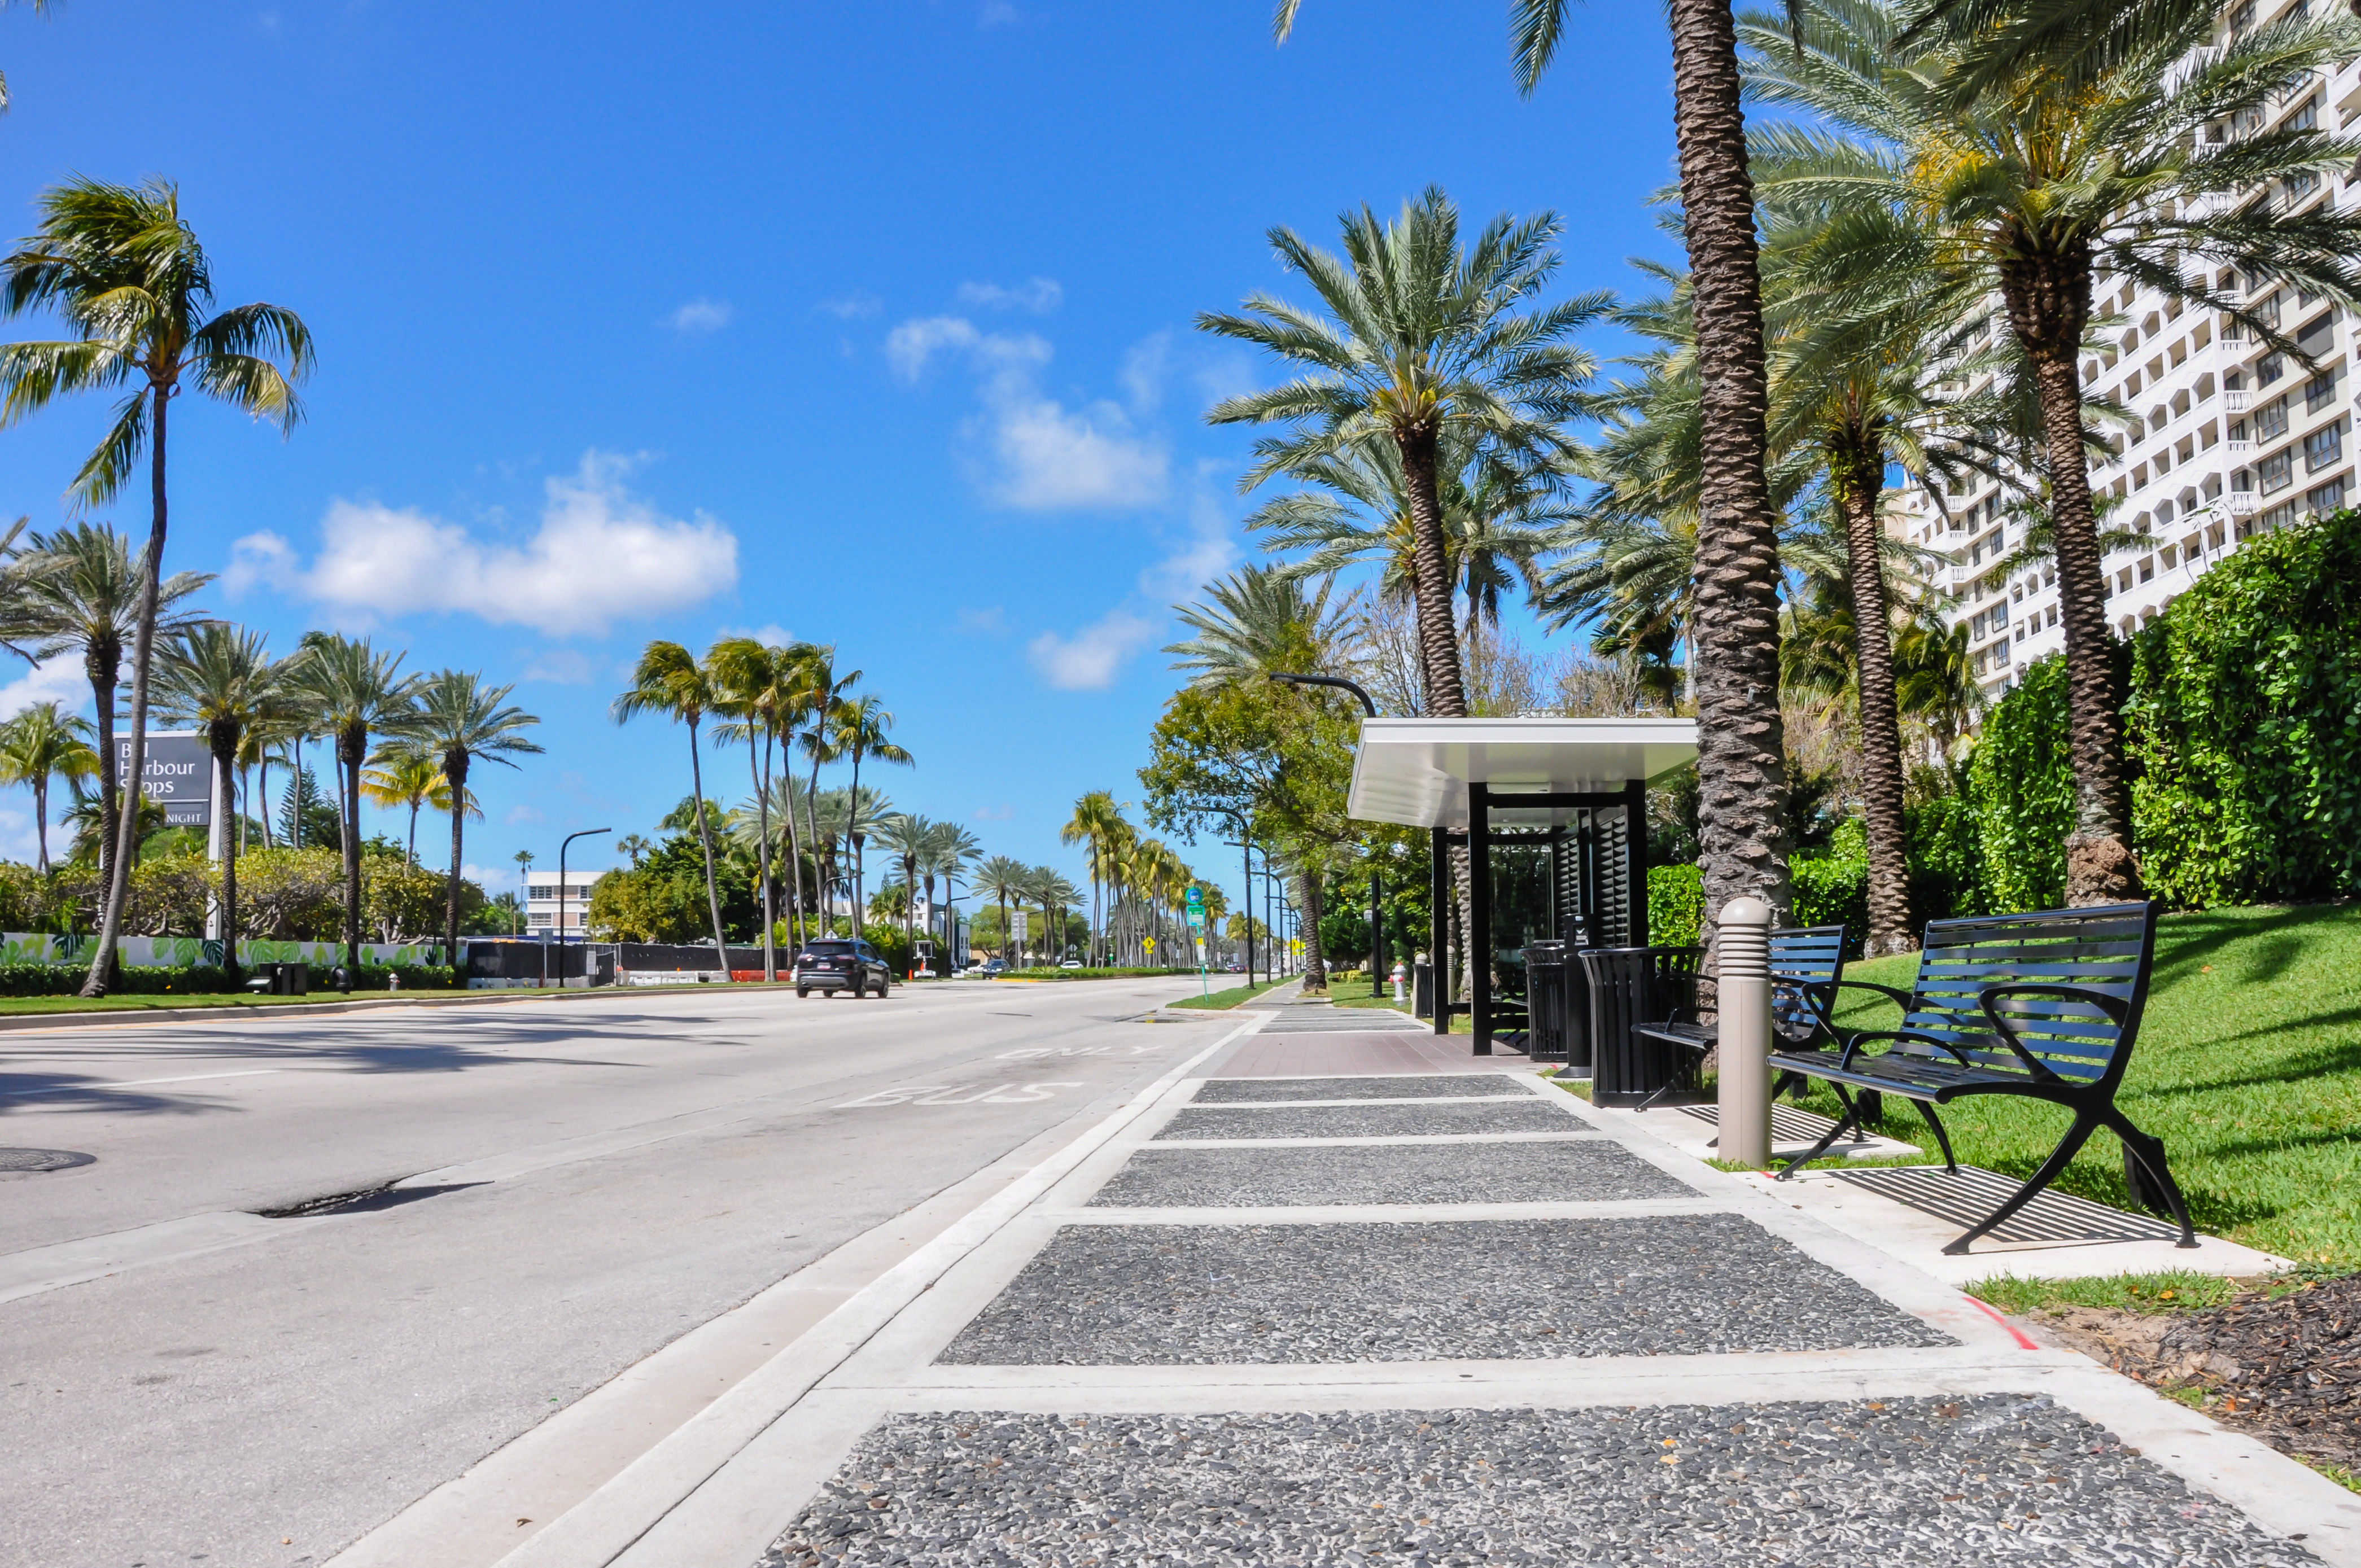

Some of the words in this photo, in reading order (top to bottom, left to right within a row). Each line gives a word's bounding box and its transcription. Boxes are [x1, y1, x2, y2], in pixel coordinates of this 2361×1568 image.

[121, 742, 148, 758] Bl
[120, 760, 195, 776] Hrbour
[120, 778, 174, 798] ops
[994, 1045, 1165, 1059] ONLY
[829, 1082, 1084, 1109] BUS
